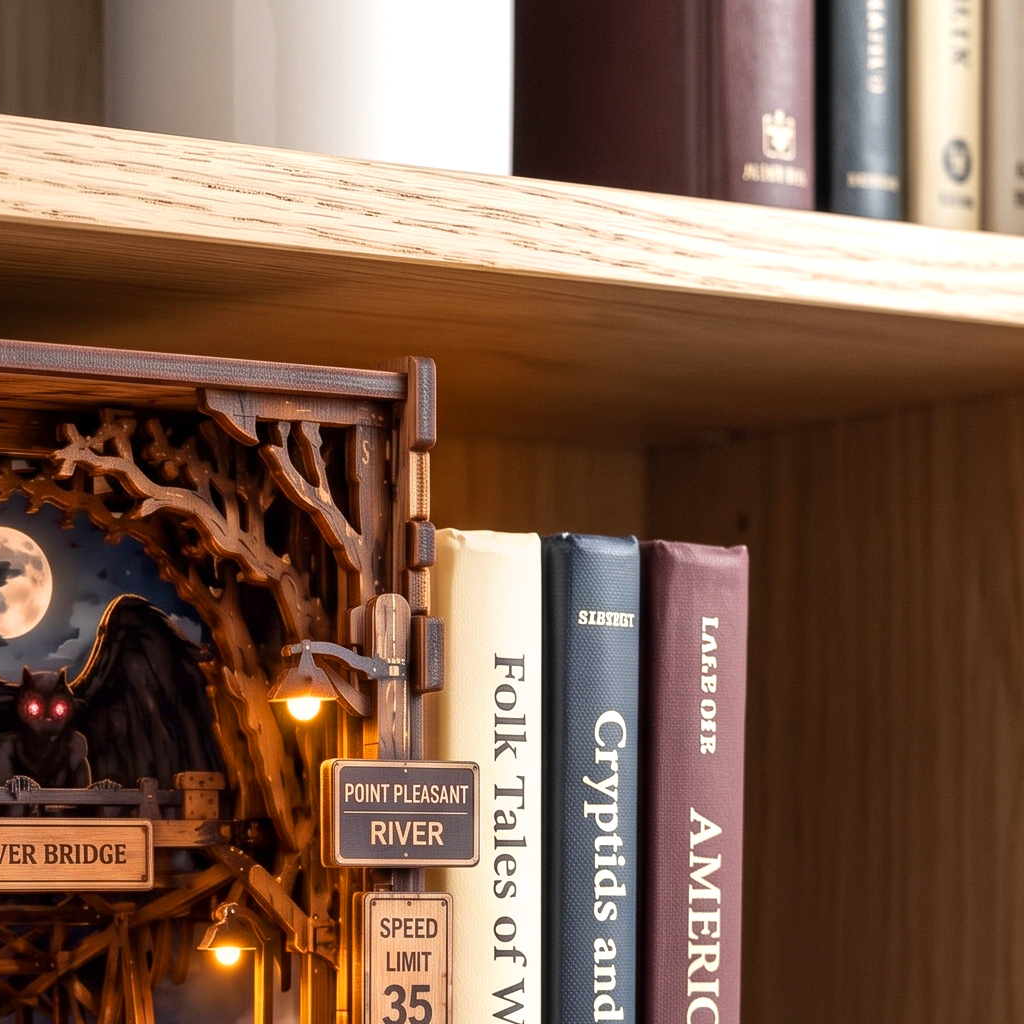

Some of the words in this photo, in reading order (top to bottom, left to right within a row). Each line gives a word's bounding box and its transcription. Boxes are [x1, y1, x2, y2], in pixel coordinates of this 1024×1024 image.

[493, 653, 526, 762] Folk
[344, 783, 390, 803] POINT
[393, 784, 469, 804] PLEASANT
[370, 820, 444, 846] RIVER
[582, 710, 628, 922] Cryptids
[43, 843, 127, 865] BRIDGE
[493, 776, 527, 899] Tales
[380, 917, 438, 939] SPEED
[492, 917, 528, 965] of
[386, 951, 432, 972] LIMIT
[593, 937, 625, 1022] and
